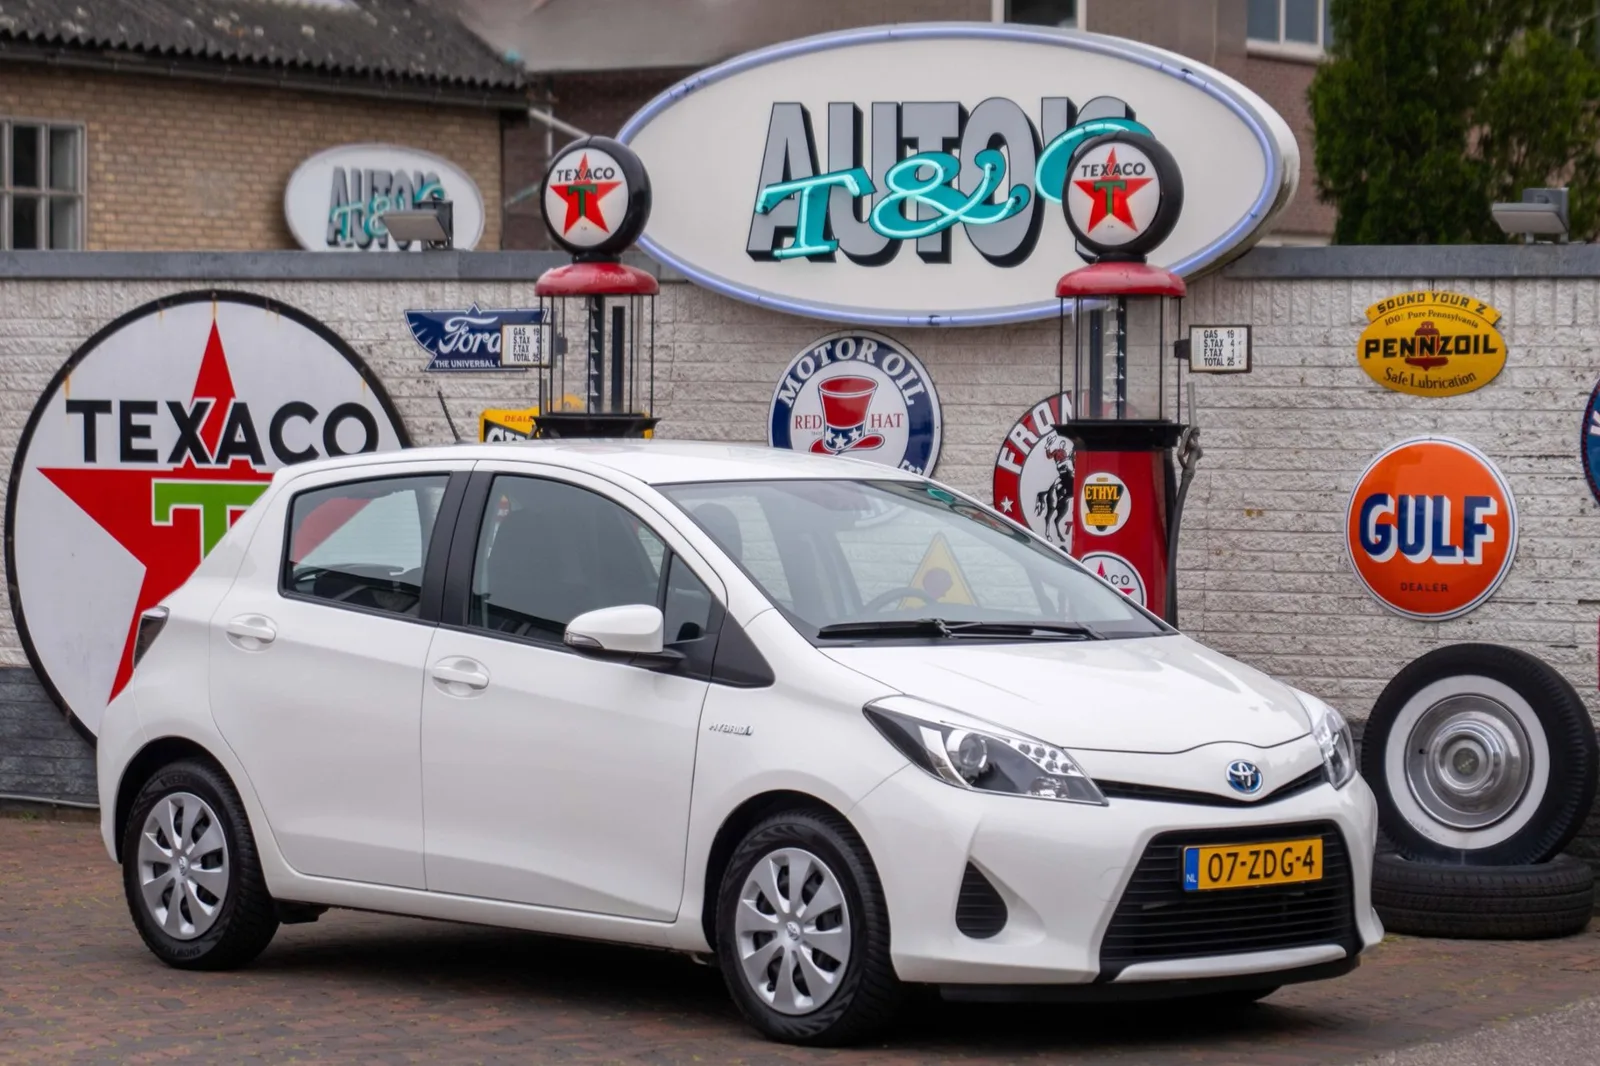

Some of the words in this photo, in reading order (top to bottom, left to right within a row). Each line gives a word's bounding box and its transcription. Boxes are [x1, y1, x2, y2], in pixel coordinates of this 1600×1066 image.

[557, 167, 615, 182] TEXACO
[1081, 162, 1146, 177] TEXACO
[1377, 292, 1426, 314] SOUND
[1431, 292, 1470, 308] YOUR
[1474, 303, 1488, 315] Z
[1407, 311, 1427, 320] Pure
[1428, 309, 1479, 329] Pennsylvania
[513, 327, 526, 336] GAS
[1204, 330, 1218, 339] GAS
[1227, 330, 1235, 339] 19
[513, 336, 530, 344] S.TAX
[1204, 339, 1224, 348] S.TAX
[1230, 339, 1235, 348] 4
[513, 345, 530, 353] F.TAX
[1204, 348, 1223, 357] F.TAX
[1364, 334, 1499, 360] PENNZOIL
[513, 353, 530, 362] TOTAL
[1204, 357, 1225, 367] TOTAL
[1227, 357, 1235, 367] 25
[434, 360, 450, 368] THE
[450, 359, 496, 369] UNIVERSAL
[778, 337, 878, 408] MOTOR
[881, 352, 926, 407] OIL
[1384, 366, 1409, 388] Safe
[1410, 371, 1477, 389] Lubrication
[504, 414, 535, 423] DEALE
[795, 414, 823, 430] RED
[870, 413, 904, 429] HAT
[65, 399, 379, 465] TEXACO
[1085, 486, 1120, 500] ETHYL
[1359, 493, 1498, 565] GULF
[1400, 582, 1449, 592] DEALER
[1208, 845, 1315, 883] 07-ZDG-4
[1186, 873, 1197, 883] NL
